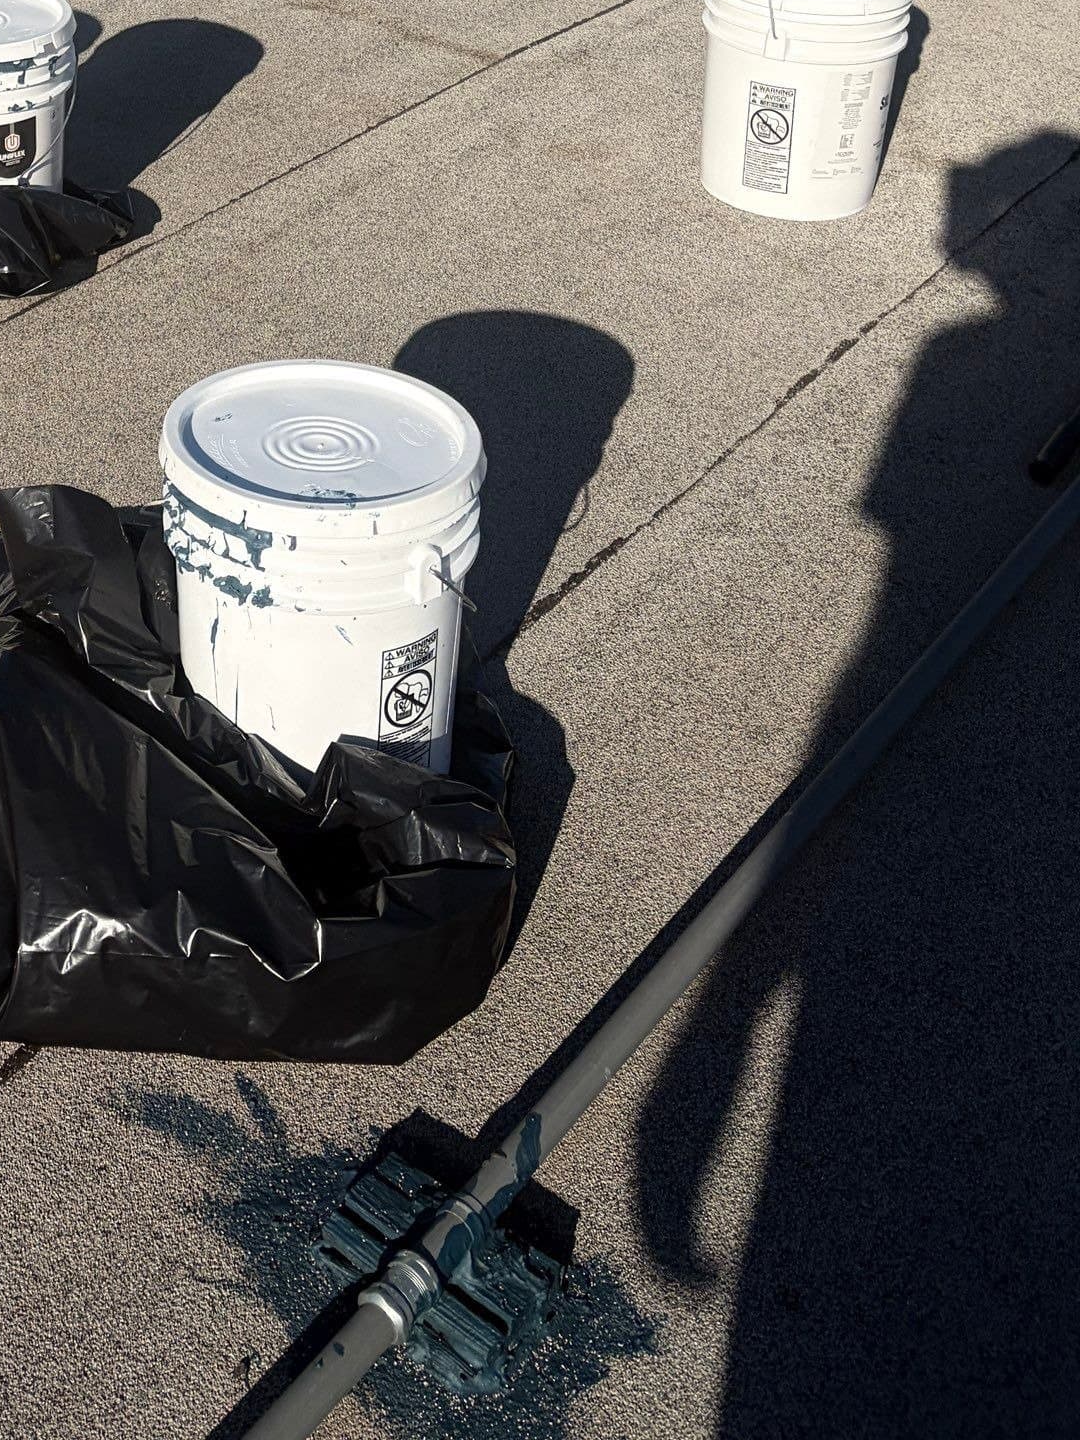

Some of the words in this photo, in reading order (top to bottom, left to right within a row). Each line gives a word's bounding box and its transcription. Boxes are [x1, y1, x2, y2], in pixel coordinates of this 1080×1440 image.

[759, 85, 794, 98] WARNING
[764, 94, 787, 103] AVISO
[396, 633, 436, 657] WARNING
[404, 645, 430, 663] AVISO
